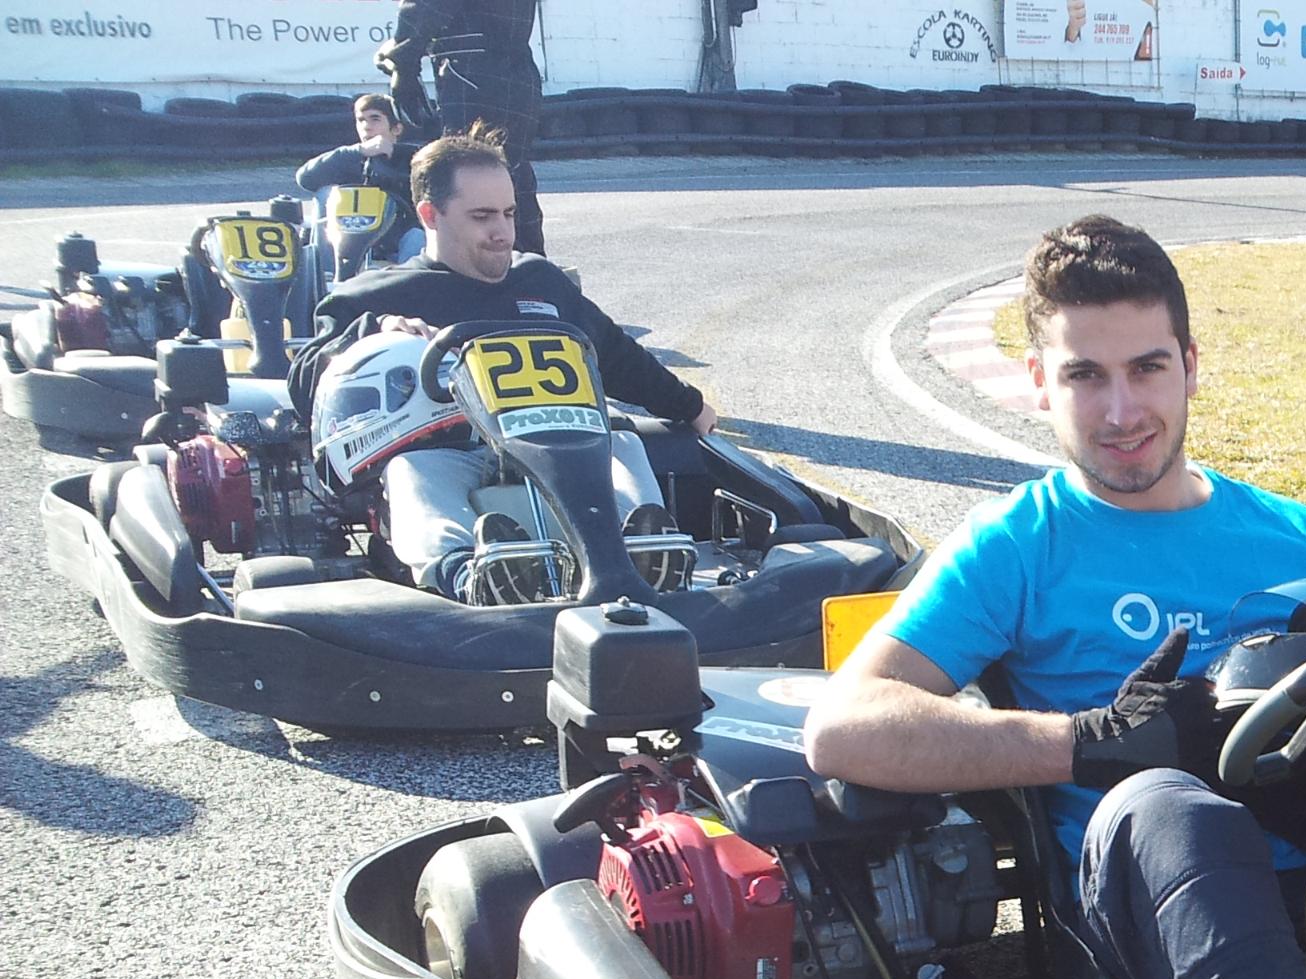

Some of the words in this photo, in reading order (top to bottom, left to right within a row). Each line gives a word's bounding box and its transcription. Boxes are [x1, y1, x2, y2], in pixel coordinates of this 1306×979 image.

[6, 16, 42, 35] em
[51, 11, 152, 38] exclusivo
[206, 17, 262, 41] The
[272, 19, 359, 42] Power
[368, 21, 394, 42] of
[909, 10, 947, 59] ESCOLA
[954, 9, 997, 63] KARTING
[932, 49, 979, 63] EUROINDY
[353, 189, 359, 213] 1
[234, 225, 288, 260] 18
[480, 339, 579, 398] 25
[1167, 612, 1210, 636] IPL
